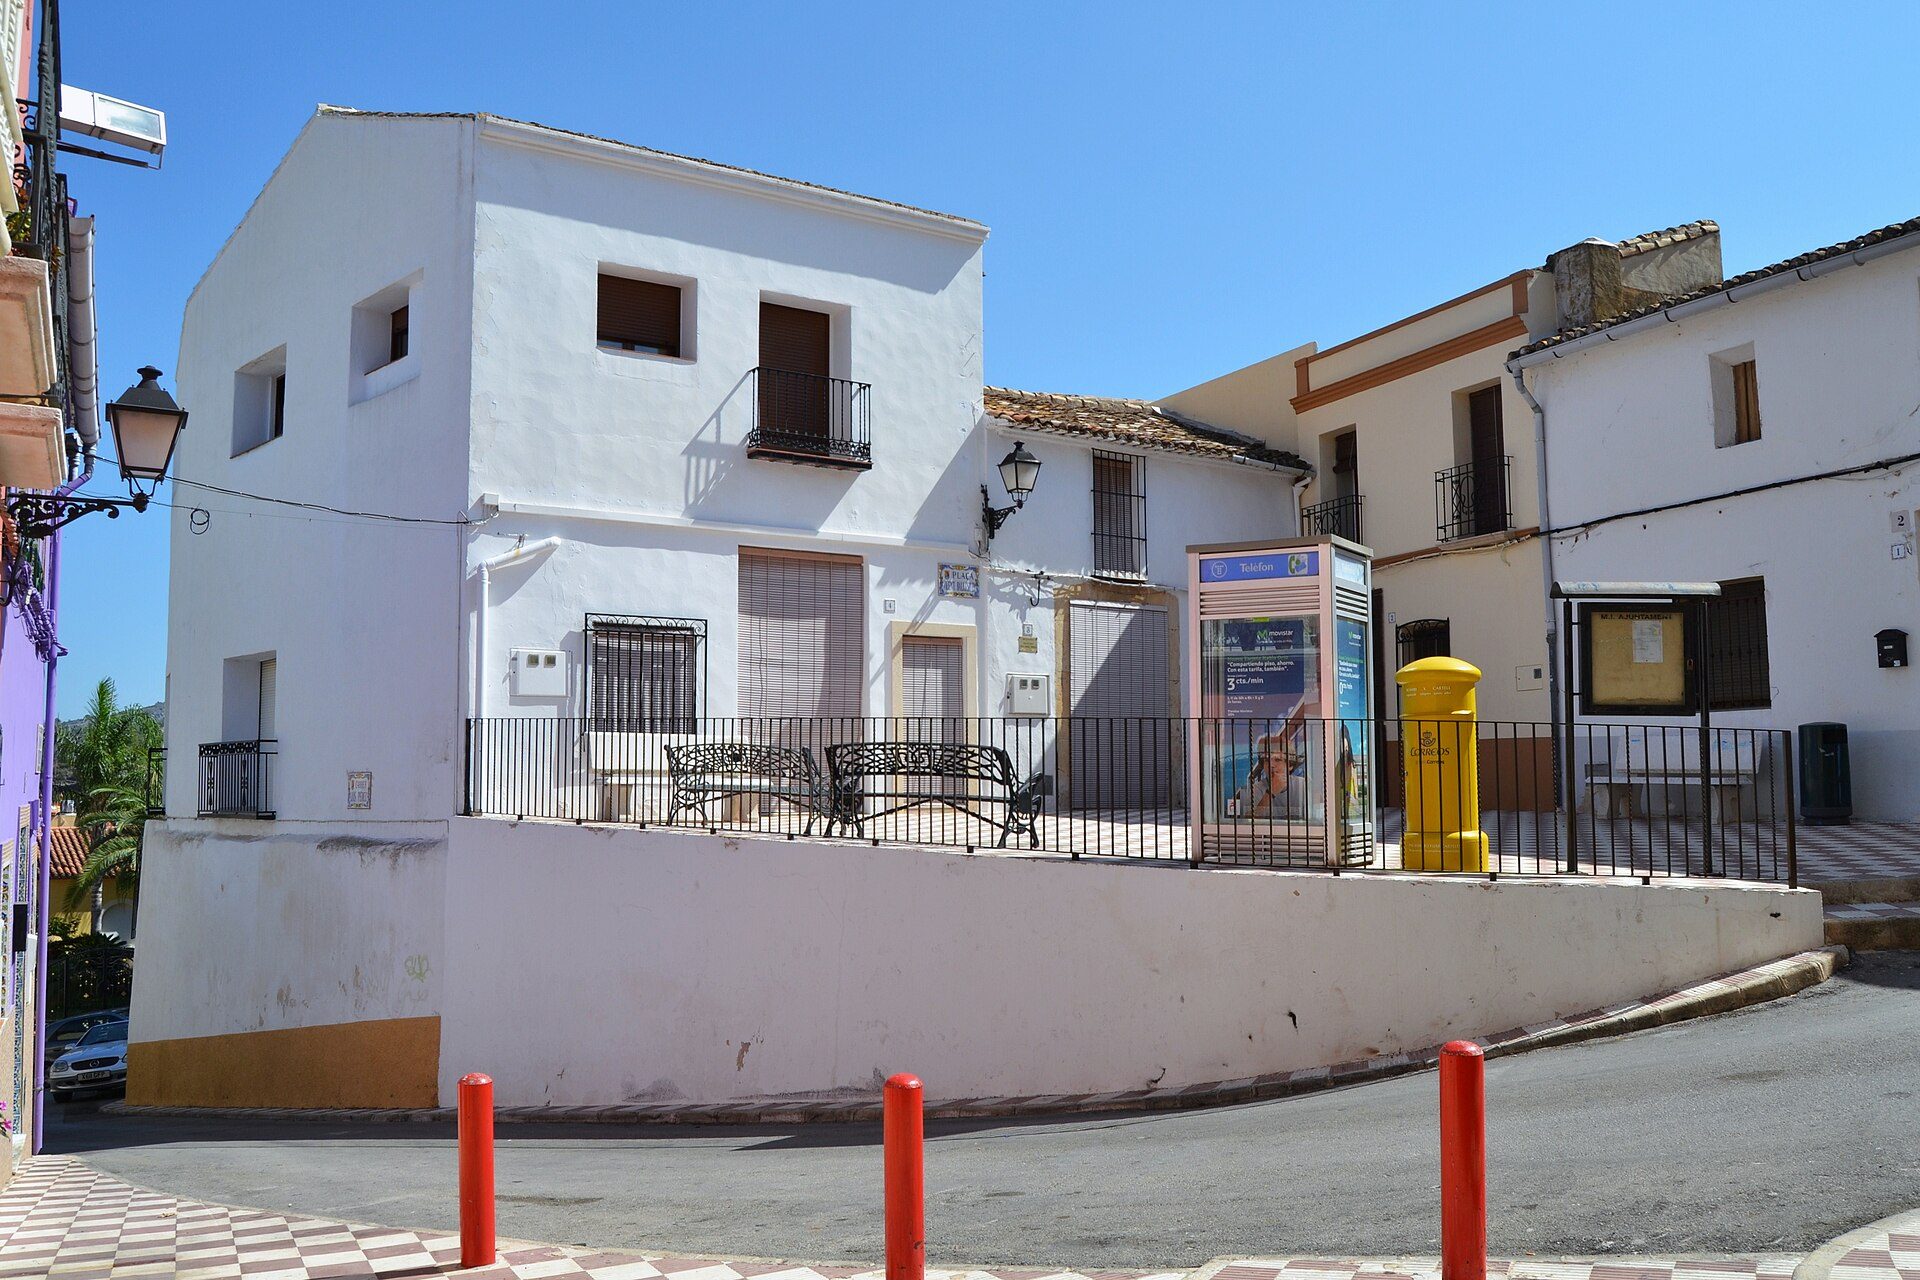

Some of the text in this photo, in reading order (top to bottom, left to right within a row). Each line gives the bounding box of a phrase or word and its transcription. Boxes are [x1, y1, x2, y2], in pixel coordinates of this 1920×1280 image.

[1897, 515, 1905, 526] 2
[952, 571, 974, 580] PLAÇA
[1227, 678, 1236, 691] 3
[1410, 747, 1450, 757] CORREOS
